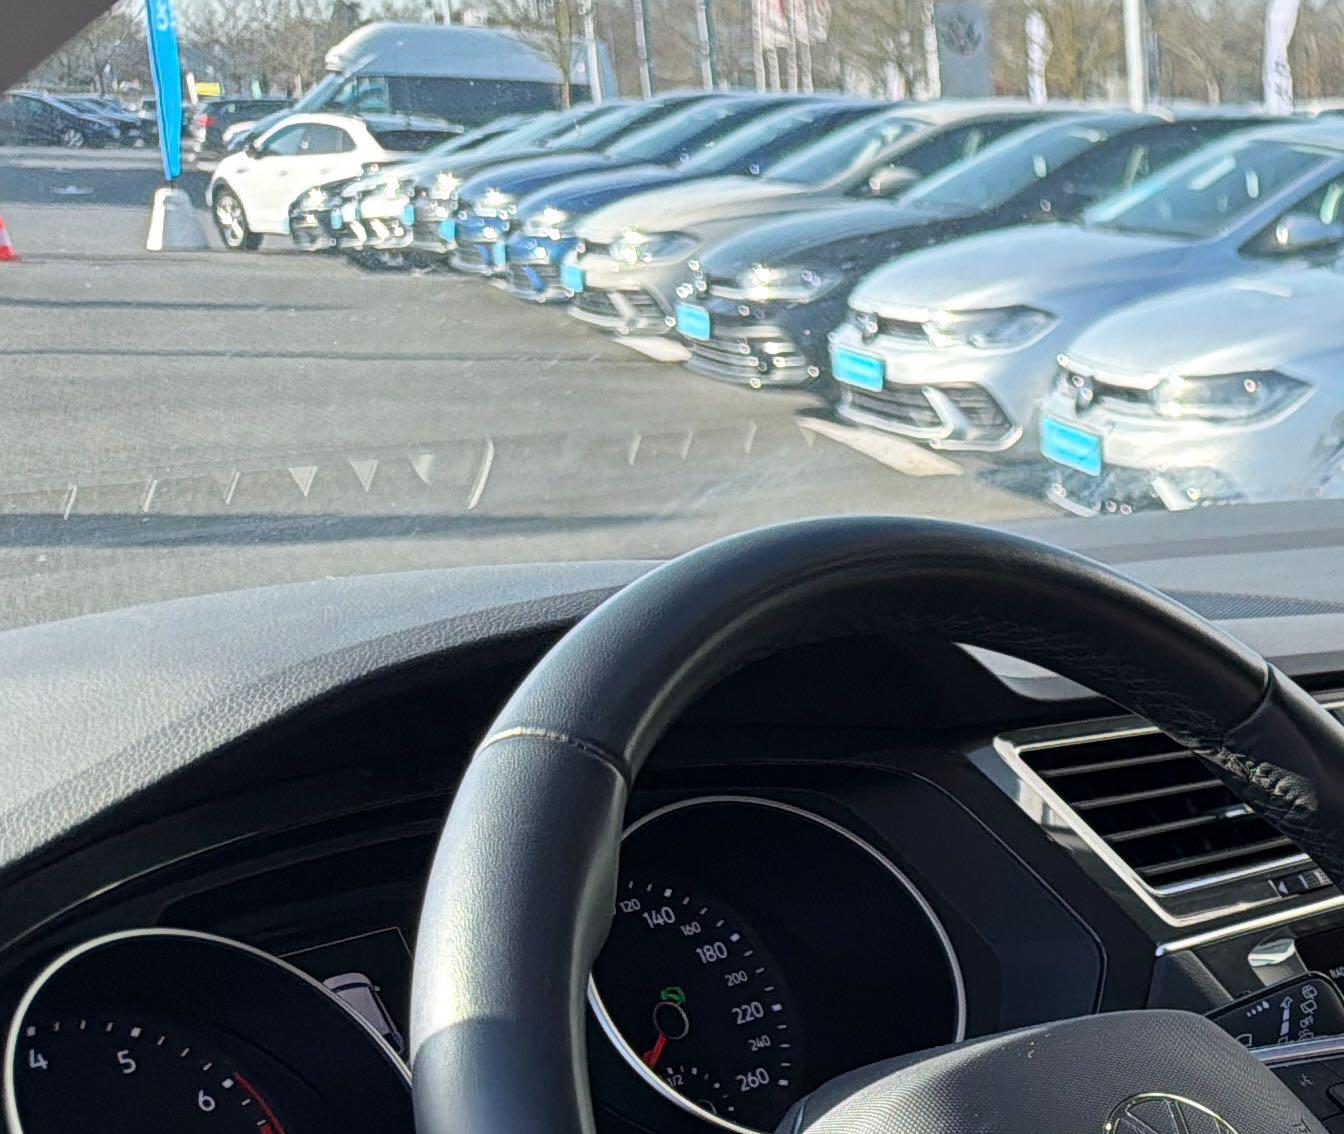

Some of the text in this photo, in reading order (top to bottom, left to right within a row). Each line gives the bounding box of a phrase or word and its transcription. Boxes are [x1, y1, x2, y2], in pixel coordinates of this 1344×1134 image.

[619, 898, 641, 913] 120
[643, 906, 675, 928] 140
[680, 921, 701, 936] 160
[696, 942, 728, 964] 180
[724, 971, 748, 987] 200
[731, 1001, 764, 1025] 220
[1299, 1015, 1315, 1029] OFF
[748, 1034, 771, 1051] 240
[28, 1048, 49, 1070] 4
[116, 1049, 137, 1074] 5
[736, 1067, 770, 1092] 260
[198, 1089, 216, 1112] 6
